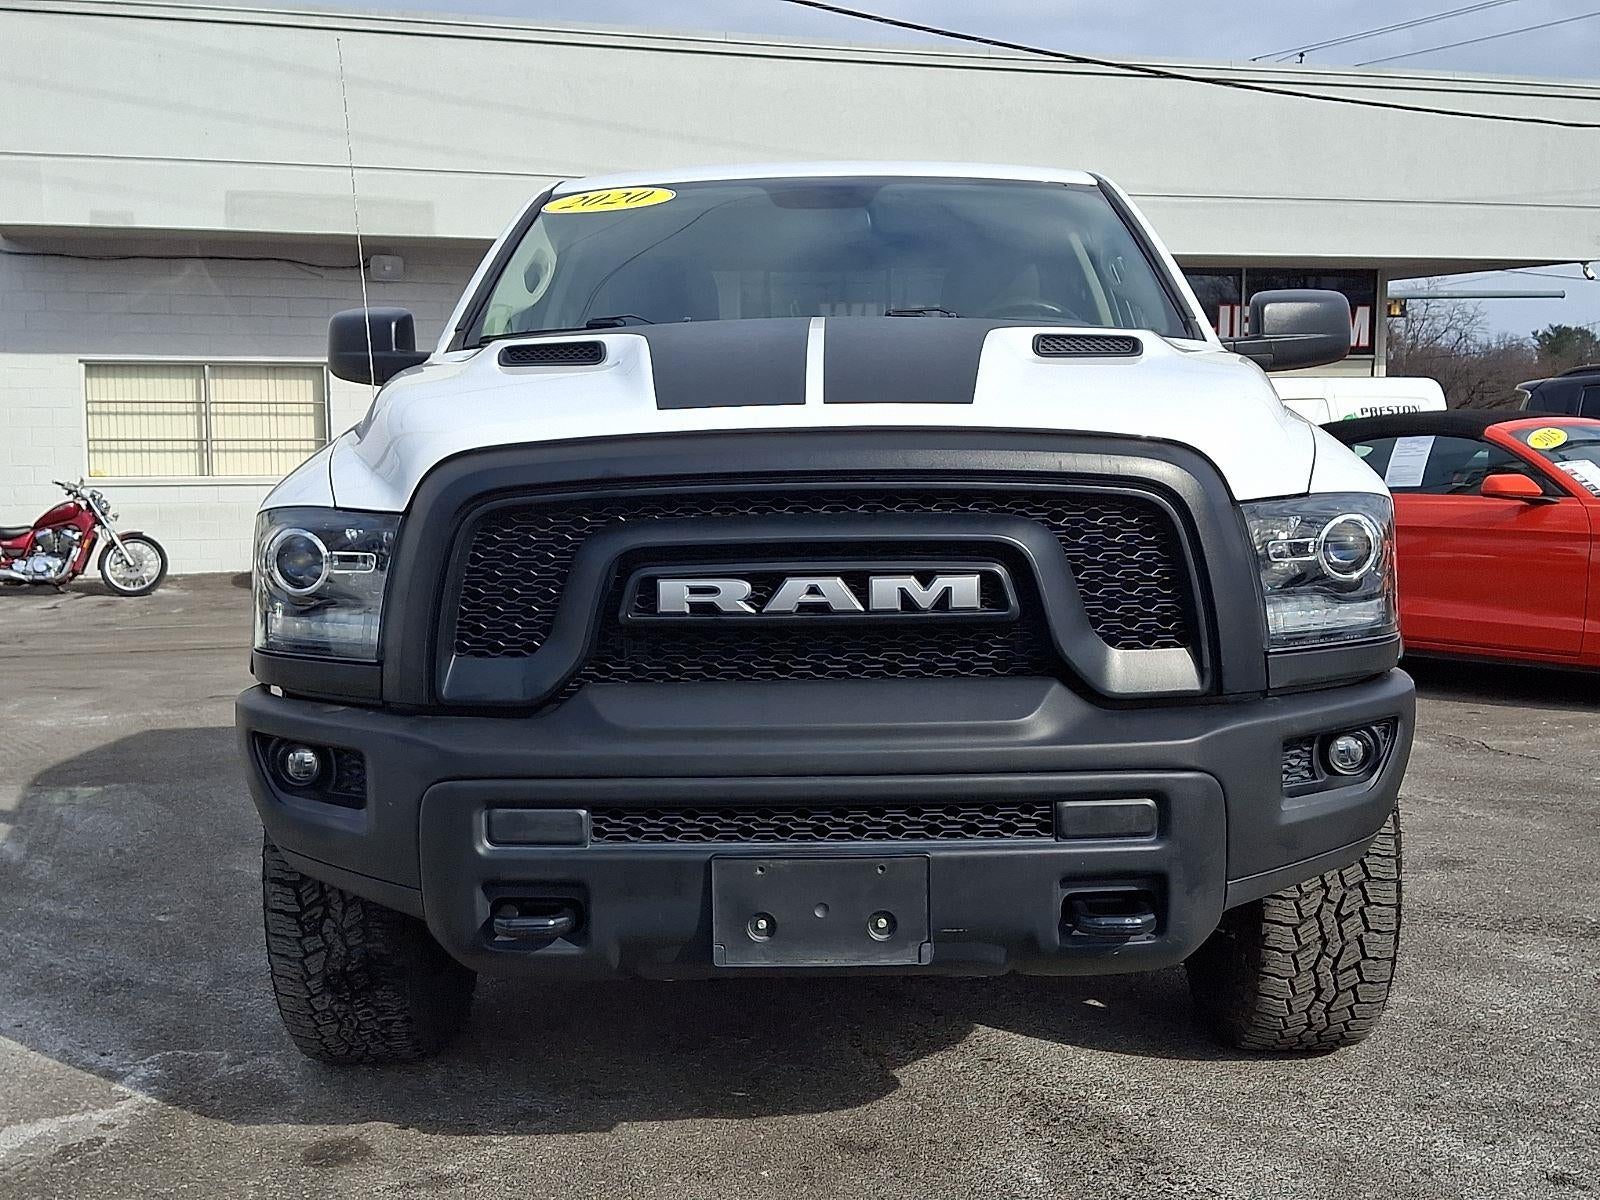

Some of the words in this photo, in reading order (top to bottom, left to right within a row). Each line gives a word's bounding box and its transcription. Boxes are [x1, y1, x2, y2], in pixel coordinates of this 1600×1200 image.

[558, 190, 656, 210] 2020
[1360, 404, 1421, 417] PRESTON
[656, 573, 982, 614] RAM
